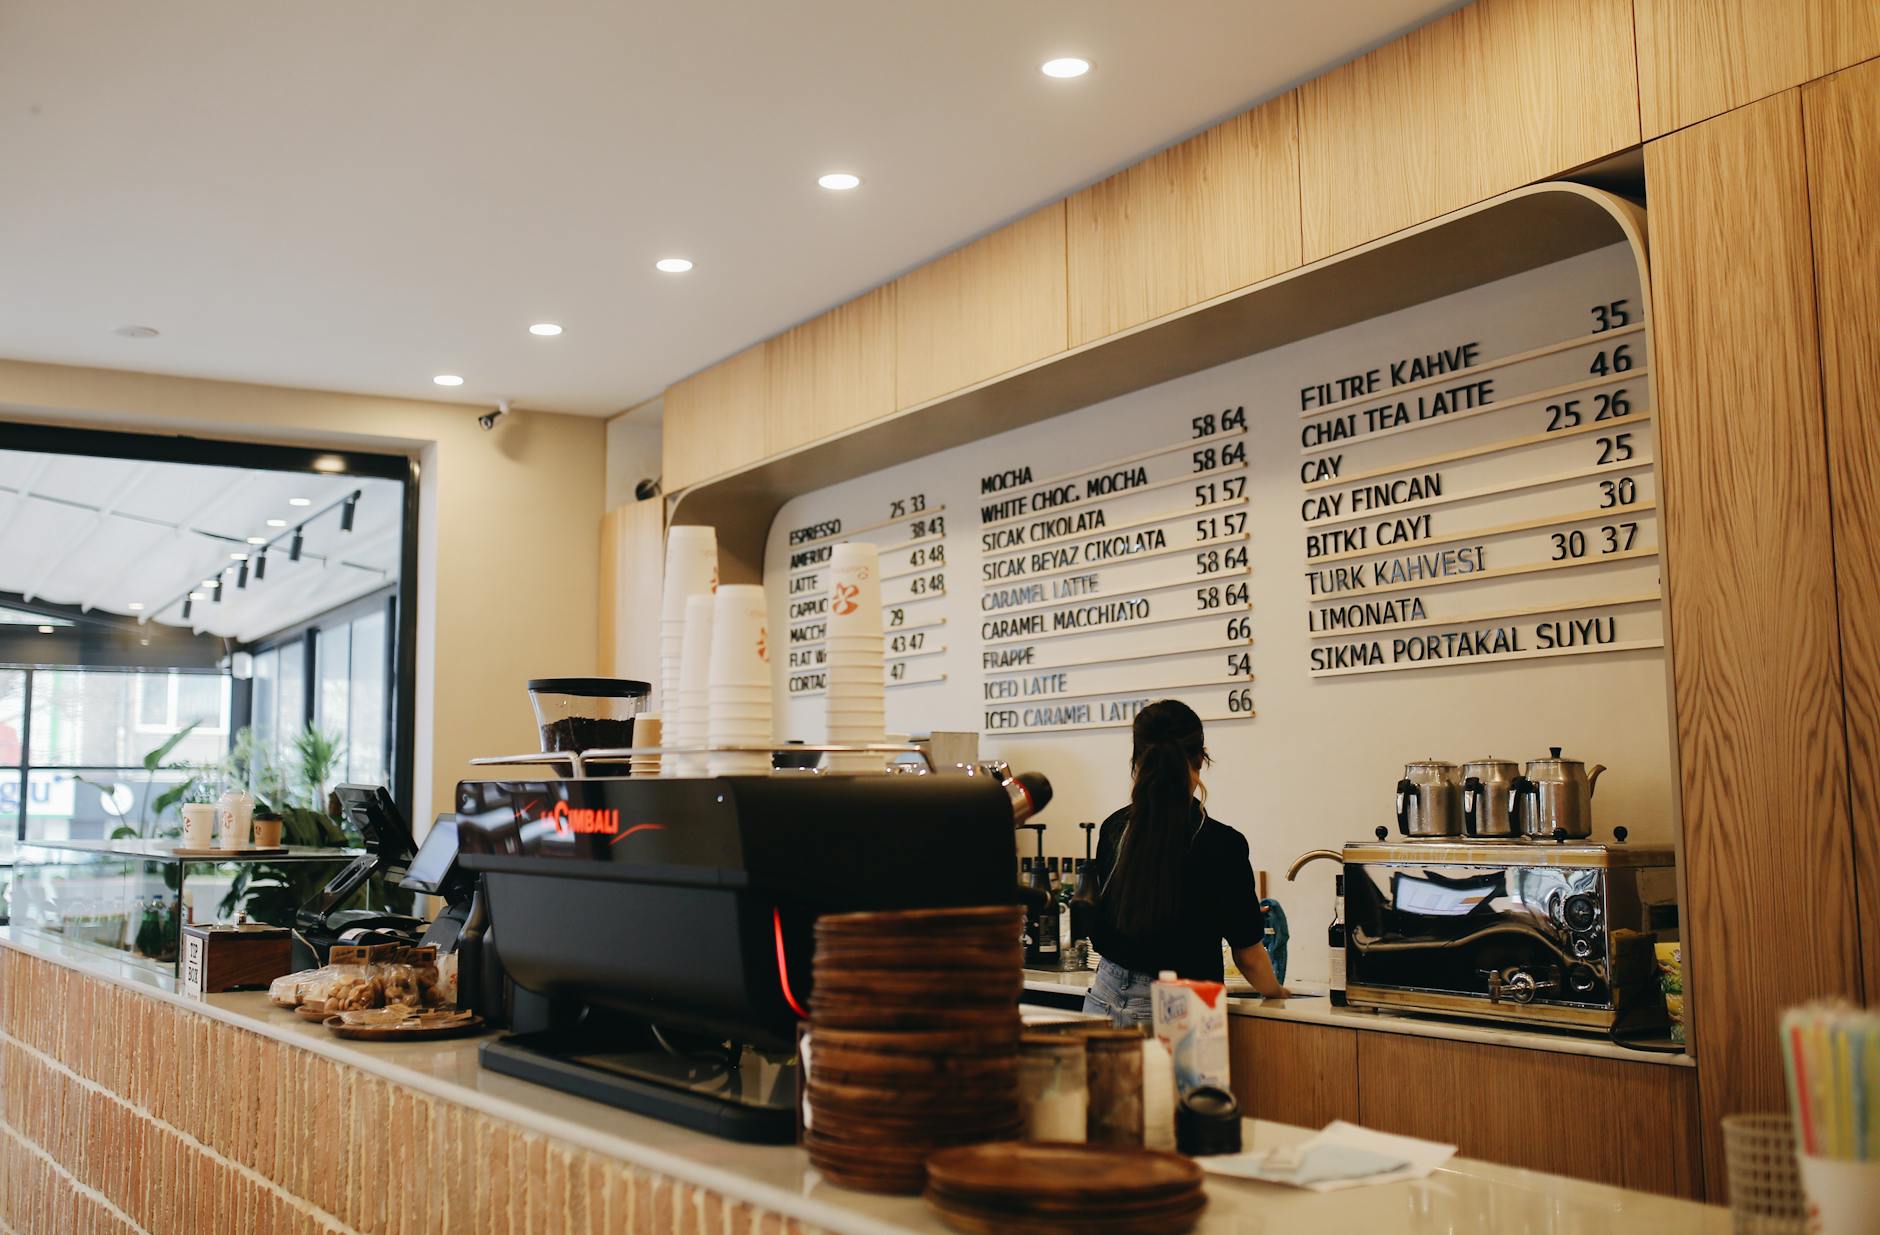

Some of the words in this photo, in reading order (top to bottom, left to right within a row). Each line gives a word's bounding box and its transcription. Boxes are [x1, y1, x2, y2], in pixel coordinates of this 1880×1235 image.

[1300, 369, 1380, 411] FILTRE
[1391, 342, 1480, 386] KAHVE
[1591, 300, 1630, 334] 35
[1302, 415, 1356, 448] CHAI
[1364, 402, 1410, 433] TEA
[1418, 379, 1495, 421] LATTE
[1589, 345, 1632, 376] 46
[981, 466, 1033, 495] MOCHA
[1192, 414, 1215, 439] 58
[1221, 407, 1245, 431] 64
[1301, 455, 1343, 484] CAY
[1545, 400, 1582, 432] 25
[1594, 389, 1631, 422] 26
[981, 497, 1027, 524] WHITE
[1087, 467, 1148, 498] MOCHA
[1193, 448, 1216, 473] 58
[1222, 442, 1245, 466] 64
[1302, 493, 1343, 522] CAY
[1352, 473, 1443, 513] FINCAN
[1596, 433, 1633, 465] 25
[789, 519, 841, 546] ESPRESSO
[890, 500, 905, 518] 25
[911, 494, 925, 513] 33
[910, 521, 925, 539] 38
[928, 517, 944, 534] 43
[982, 527, 1025, 552] SICAK
[1030, 509, 1105, 542] CIKOLATA
[1196, 483, 1216, 507] 51
[1223, 477, 1247, 500] 57
[1306, 527, 1367, 559] BITKI
[1376, 514, 1432, 546] CAYI
[1600, 477, 1636, 509] 30
[790, 575, 818, 593] LATTE
[910, 549, 925, 566] 43
[929, 545, 944, 562] 48
[983, 557, 1026, 581] SICAK
[1032, 546, 1079, 573] BEYAZ
[1085, 529, 1166, 562] CIKOLATA
[1197, 519, 1217, 541] 51
[1224, 512, 1247, 536] 57
[1305, 564, 1365, 595] TURK
[1374, 545, 1486, 586] KAHVESI
[1551, 530, 1585, 561] 30
[1601, 522, 1638, 554] 37
[911, 578, 925, 594] 43
[929, 574, 944, 591] 48
[982, 582, 1047, 611] CARAMEL
[1053, 573, 1099, 599] LATTE
[1197, 552, 1219, 575] 58
[1225, 547, 1248, 569] 64
[890, 609, 904, 626] 29
[982, 615, 1047, 640] CARAMEL
[1053, 599, 1149, 630] MACCHIATO
[1197, 587, 1219, 610] 58
[1226, 583, 1249, 606] 64
[1308, 597, 1427, 632] LIMONATA
[790, 652, 811, 667] FLAT
[892, 636, 906, 652] 43
[910, 633, 924, 649] 47
[891, 663, 905, 680] 47
[983, 647, 1034, 669] FRAPPE
[1227, 618, 1250, 640] 66
[1311, 641, 1384, 671] SIKMA
[1393, 627, 1527, 663] PORTAKAL
[1536, 616, 1615, 650] SUYU
[984, 681, 1018, 700] ICED
[1023, 673, 1067, 697] LATTE
[1228, 653, 1251, 676] 54
[985, 710, 1018, 729] ICED
[1024, 704, 1094, 727] CARAMEL
[1229, 690, 1253, 712] 66
